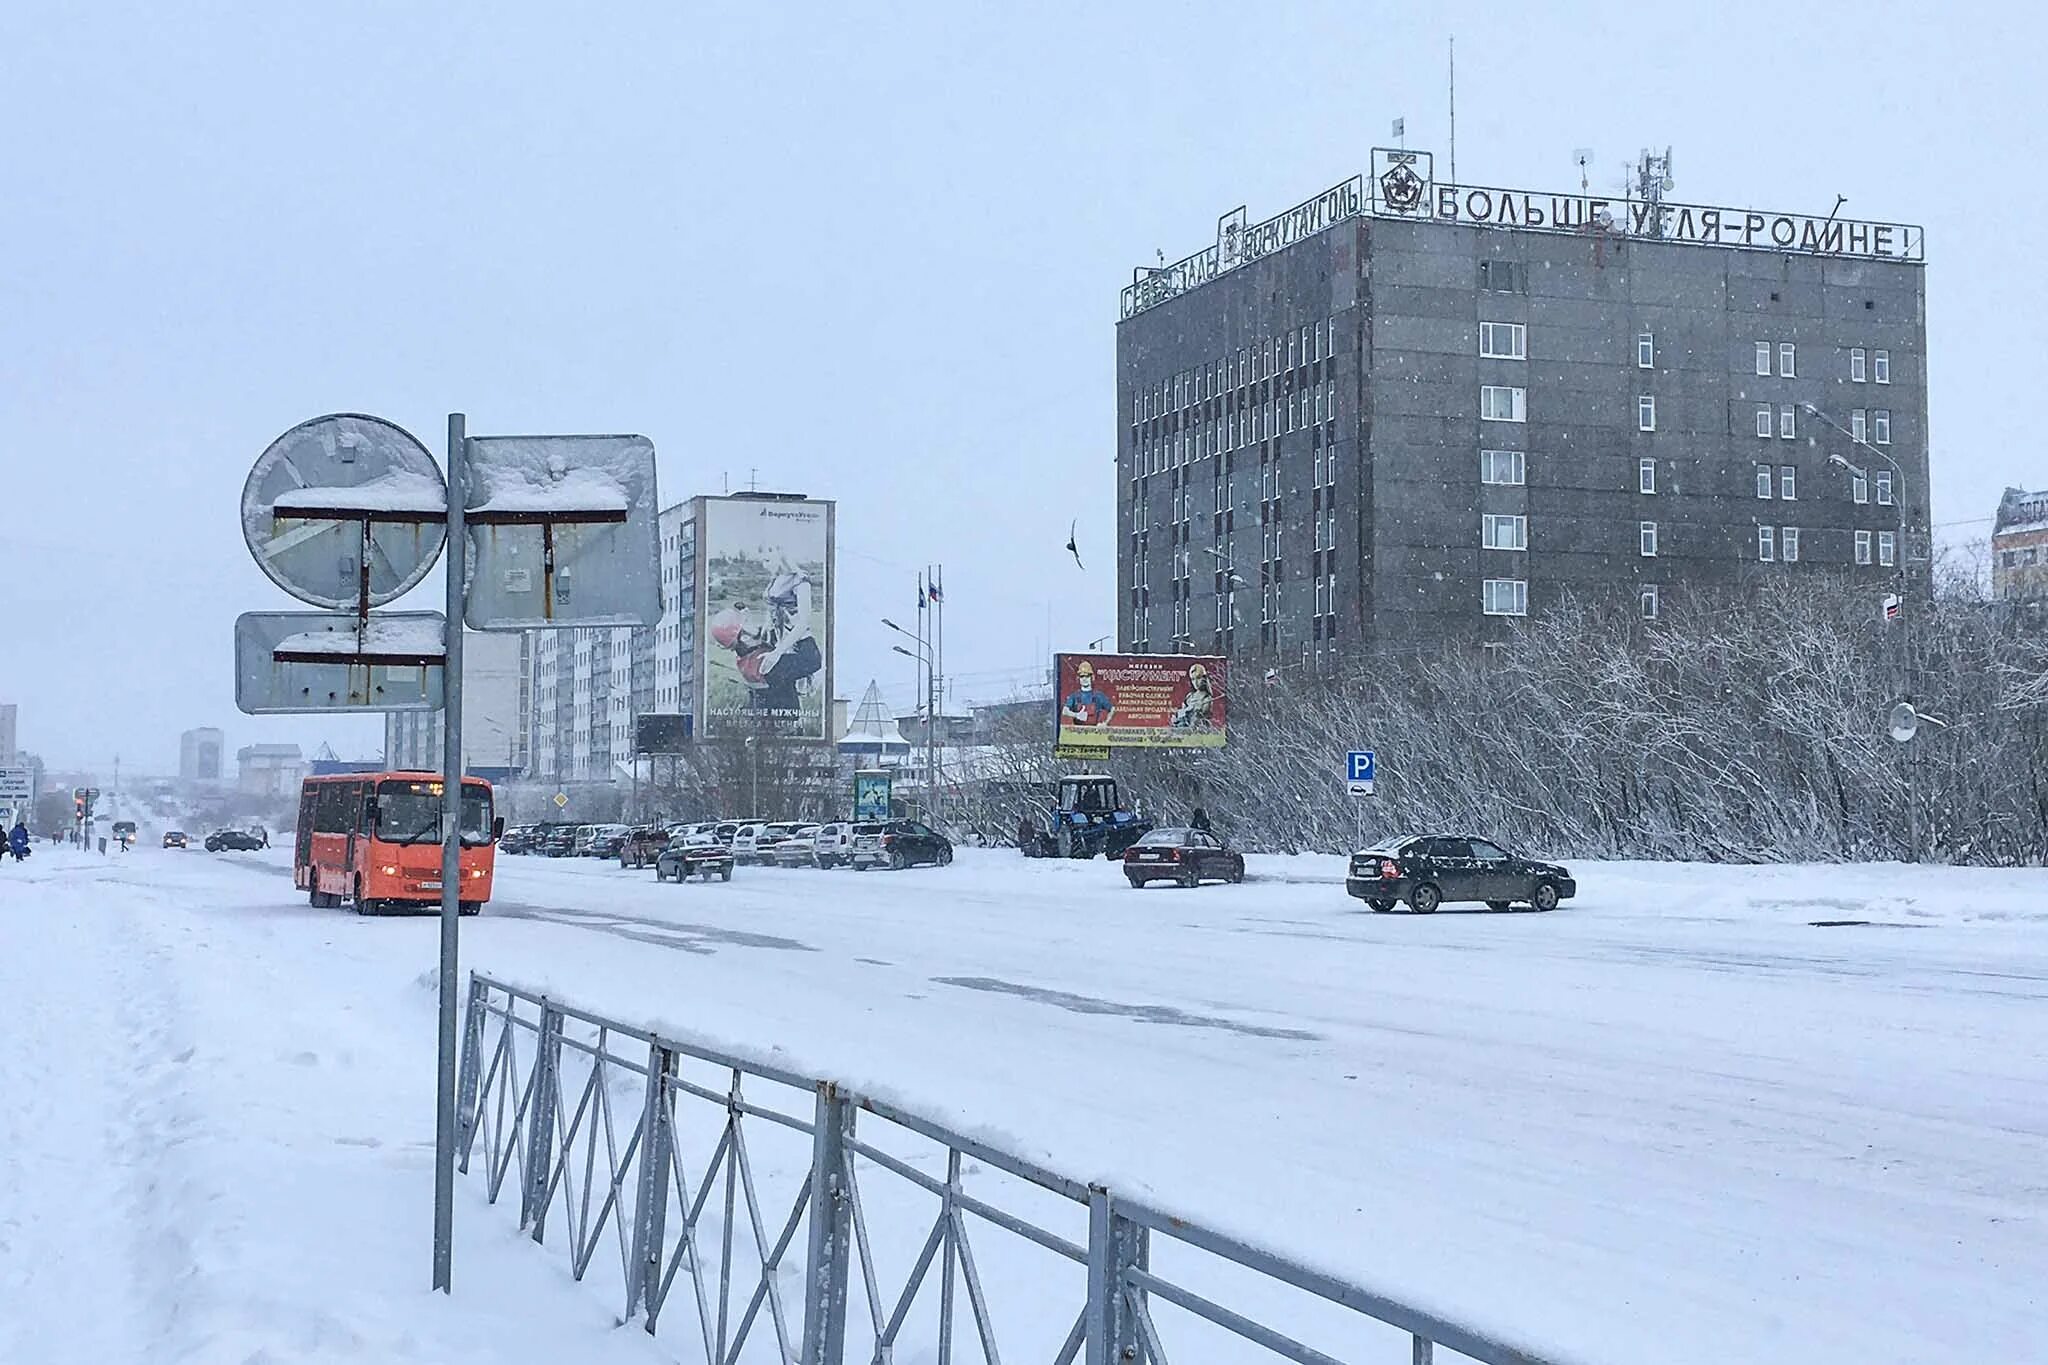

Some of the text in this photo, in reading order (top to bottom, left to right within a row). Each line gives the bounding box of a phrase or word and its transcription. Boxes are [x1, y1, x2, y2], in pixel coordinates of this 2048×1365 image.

[1243, 183, 1358, 263] ВОРКУТАУГОЛЬ
[1438, 187, 1609, 228] БОЛЬШЕ
[771, 708, 820, 717] МУЖЧИНЫ
[1354, 754, 1370, 778] P
